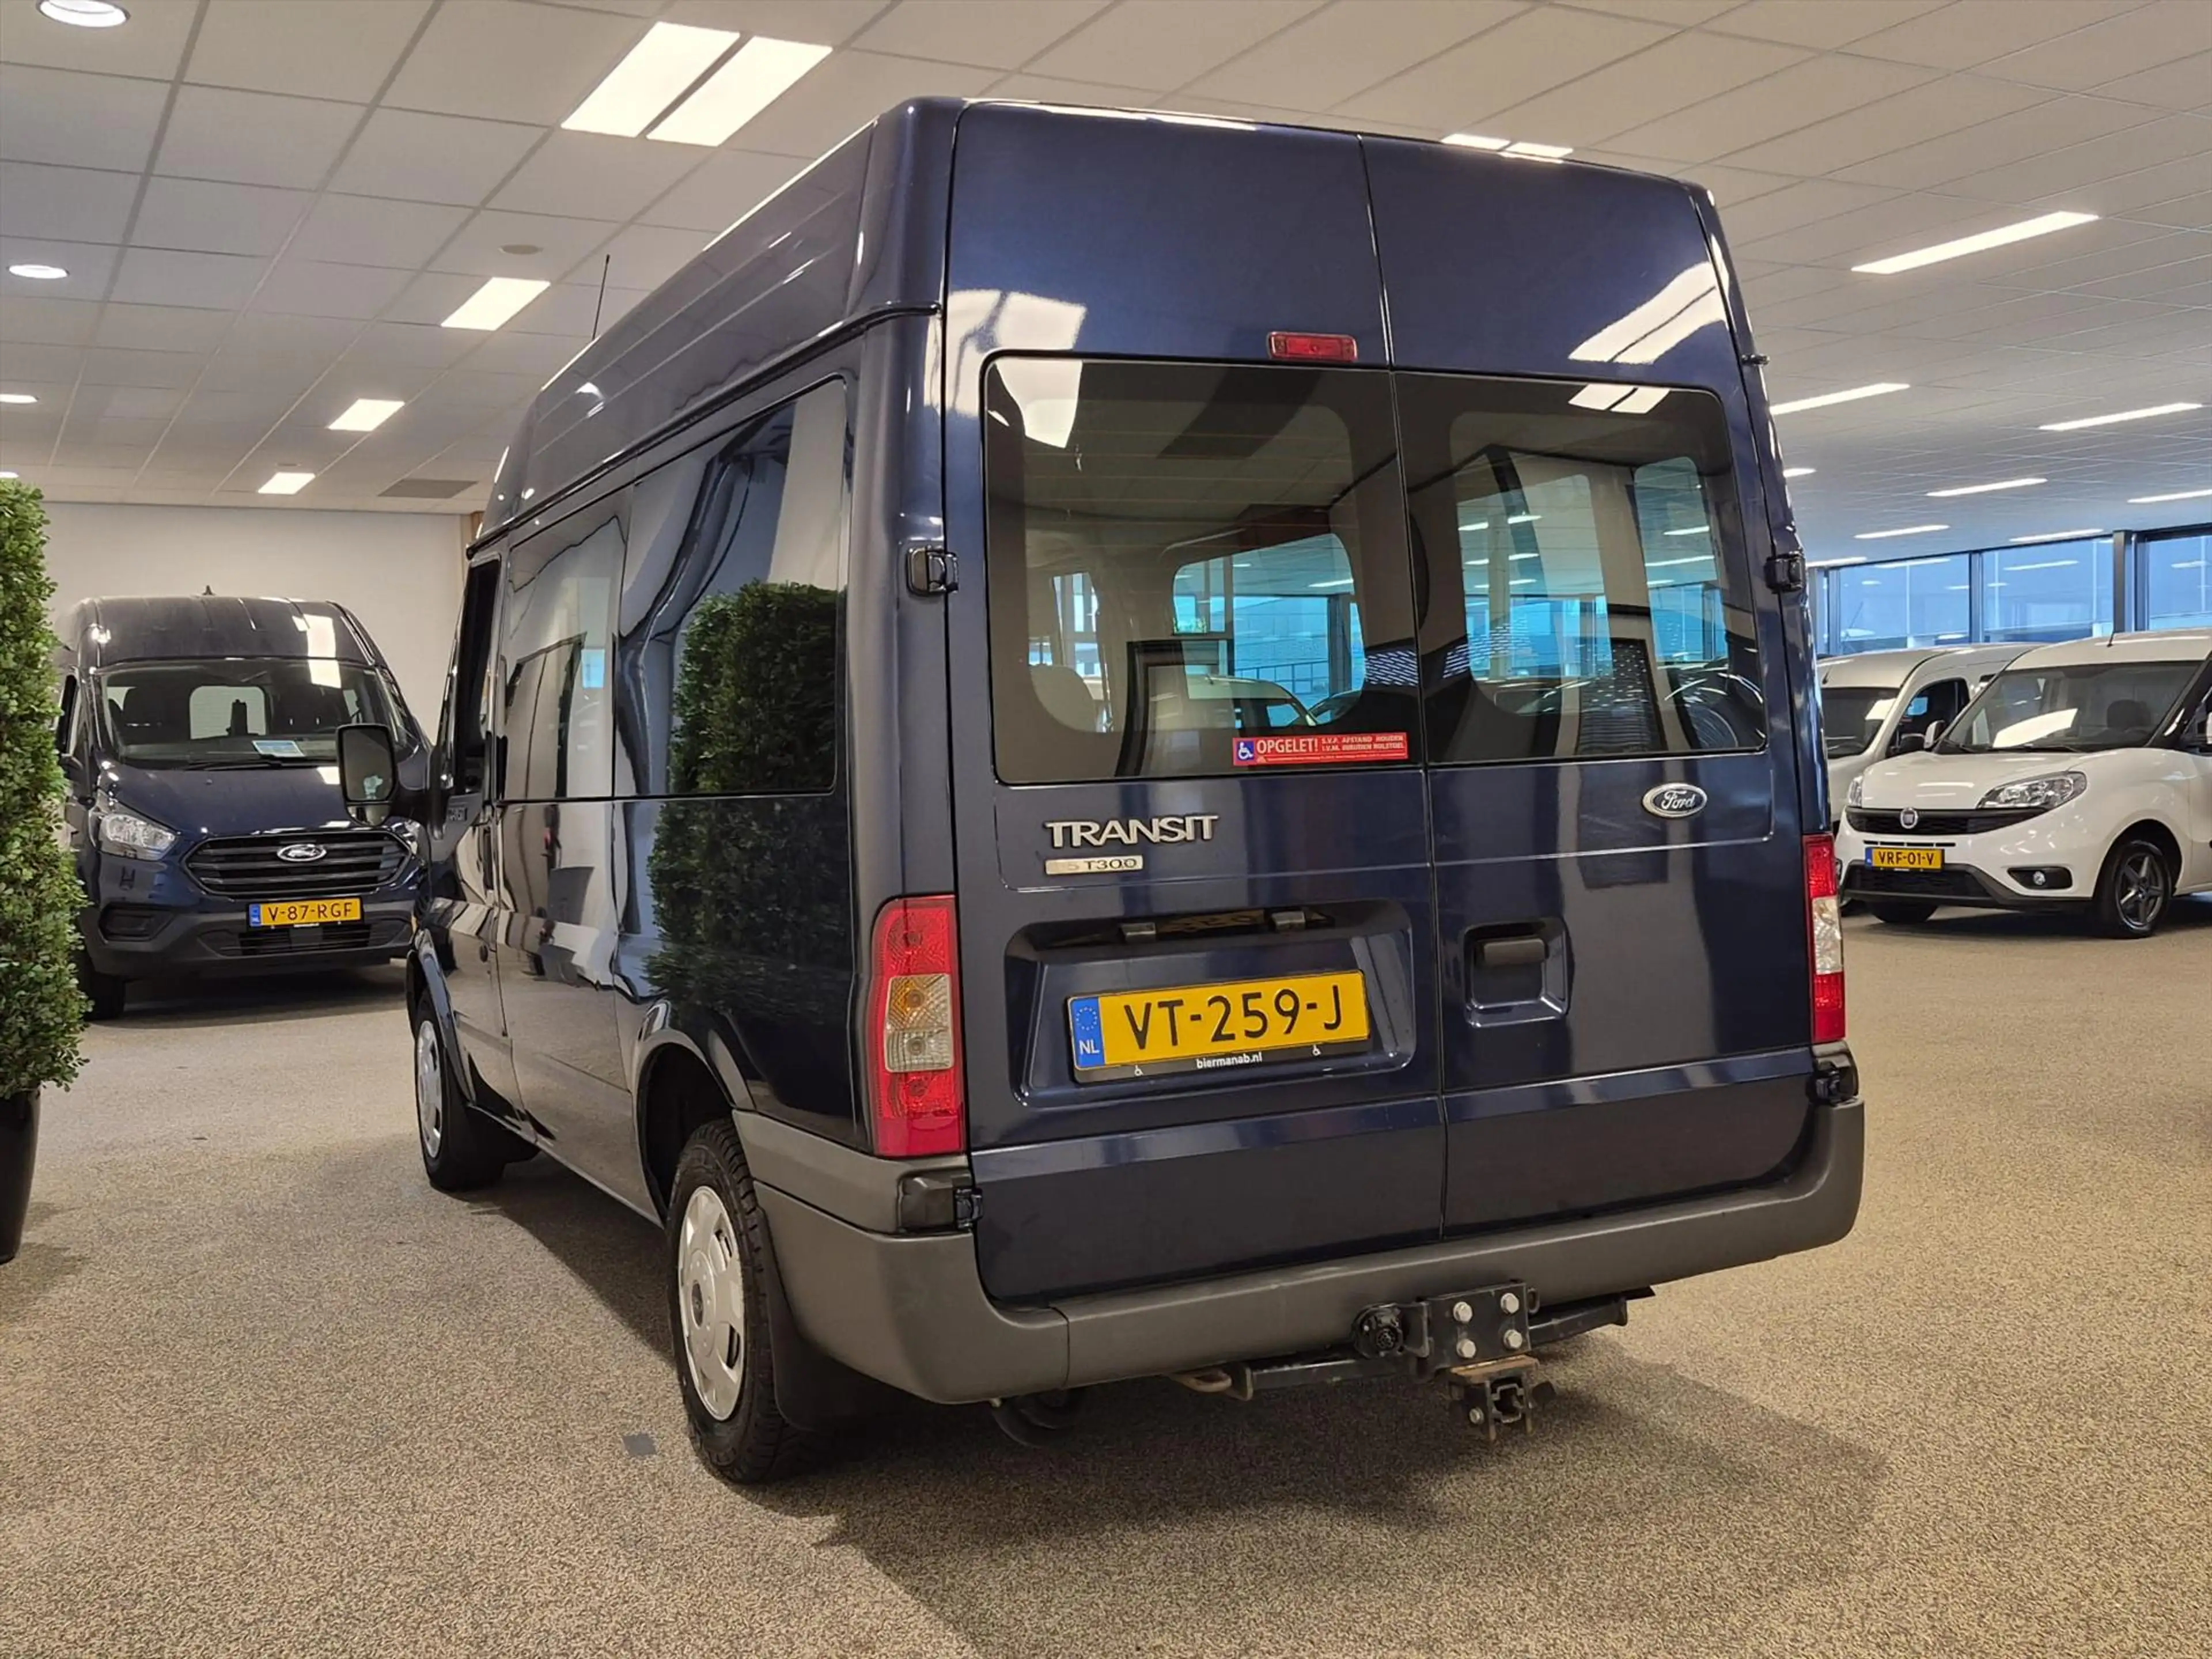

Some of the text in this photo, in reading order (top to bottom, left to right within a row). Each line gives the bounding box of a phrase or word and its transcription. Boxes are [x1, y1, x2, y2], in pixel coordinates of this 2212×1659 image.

[1256, 738, 1318, 754] OPGELET!
[1661, 790, 1696, 809] Ford
[1045, 815, 1219, 848] TRANSIT
[1083, 858, 1137, 870] T300
[1878, 851, 1934, 866] VRF-01-V
[267, 902, 353, 922] V-87-RGF
[1123, 984, 1342, 1050] VT-259-J
[1078, 1039, 1100, 1056] NL
[1196, 1051, 1263, 1070] biermanab.nl
